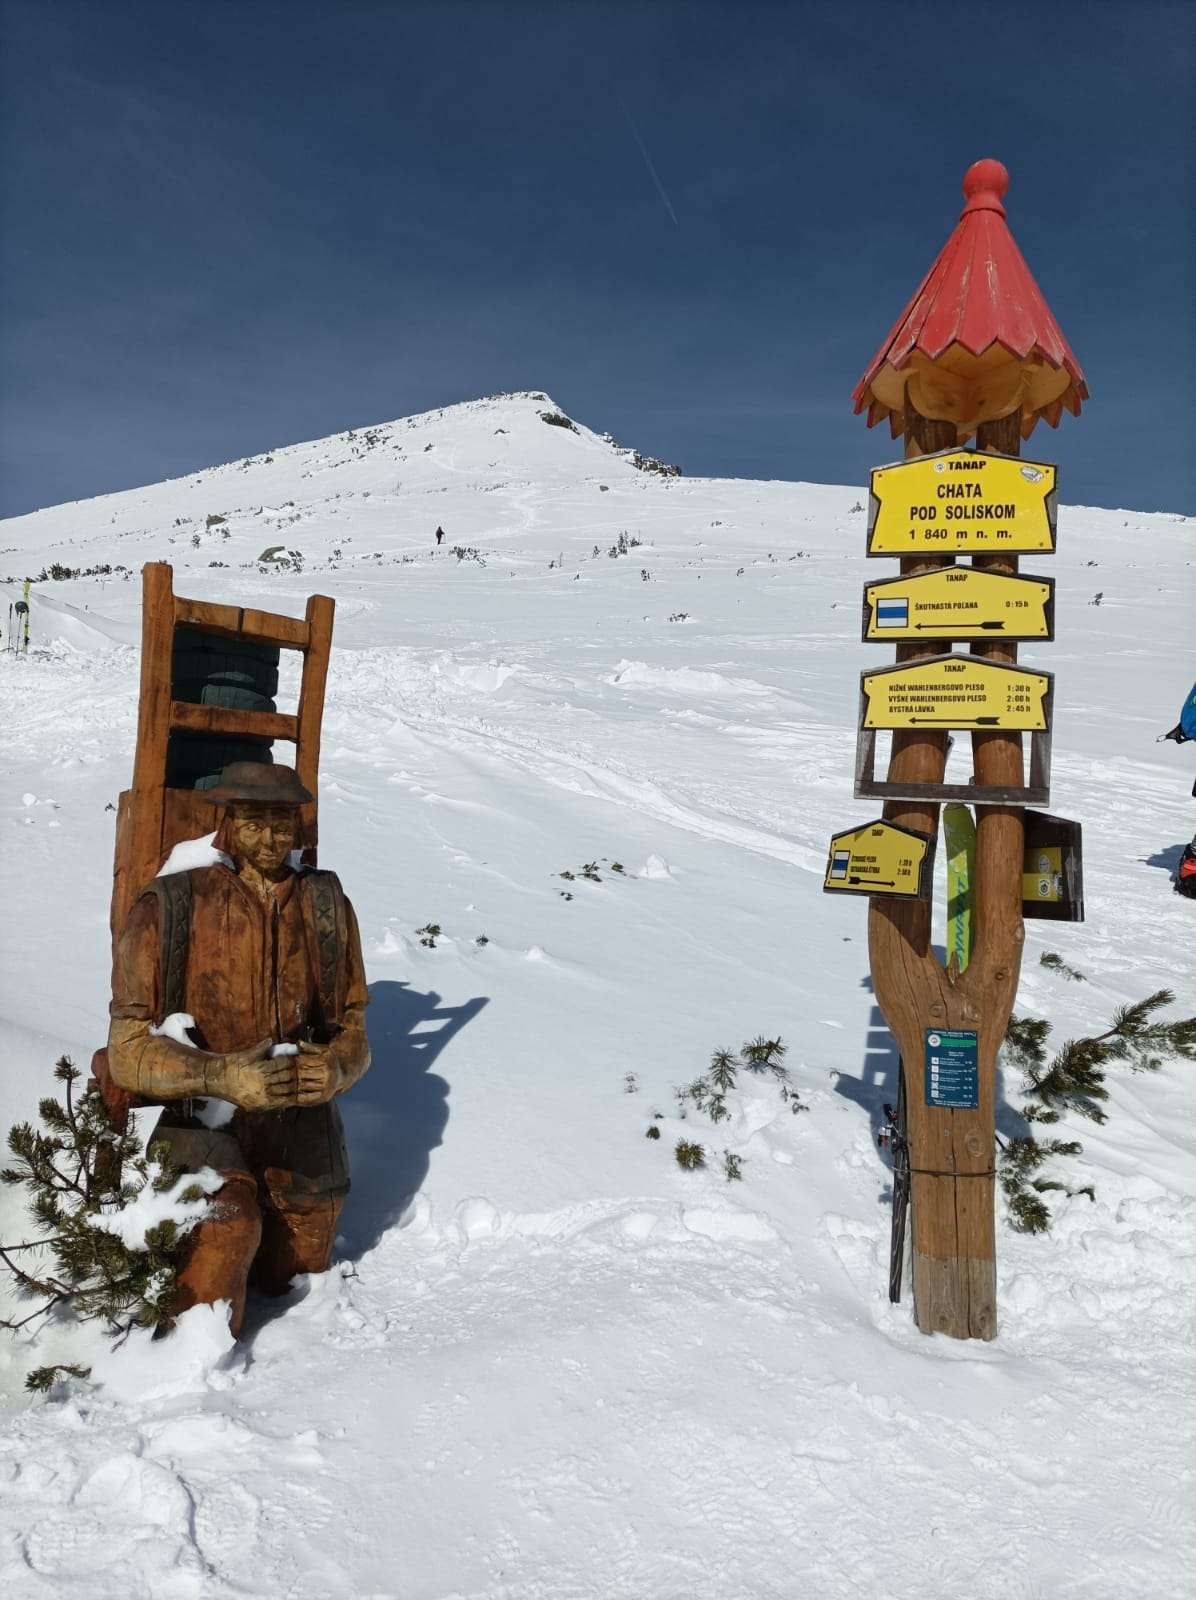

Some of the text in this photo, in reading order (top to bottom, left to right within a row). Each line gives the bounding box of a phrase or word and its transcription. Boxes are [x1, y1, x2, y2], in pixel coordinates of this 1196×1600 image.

[948, 461, 986, 470] TANAP
[937, 483, 982, 498] CHATA
[910, 504, 1016, 520] POD SOLISKOM
[909, 529, 916, 539] 1
[924, 528, 948, 540] 840
[956, 530, 968, 539] m
[945, 574, 968, 582] TANAP
[944, 665, 966, 673] TANAP
[907, 683, 964, 692] WAHLENBERGOVO
[965, 683, 985, 691] PLESO
[909, 694, 965, 702] WAHLENBERGOVO
[967, 694, 987, 702] PLESO
